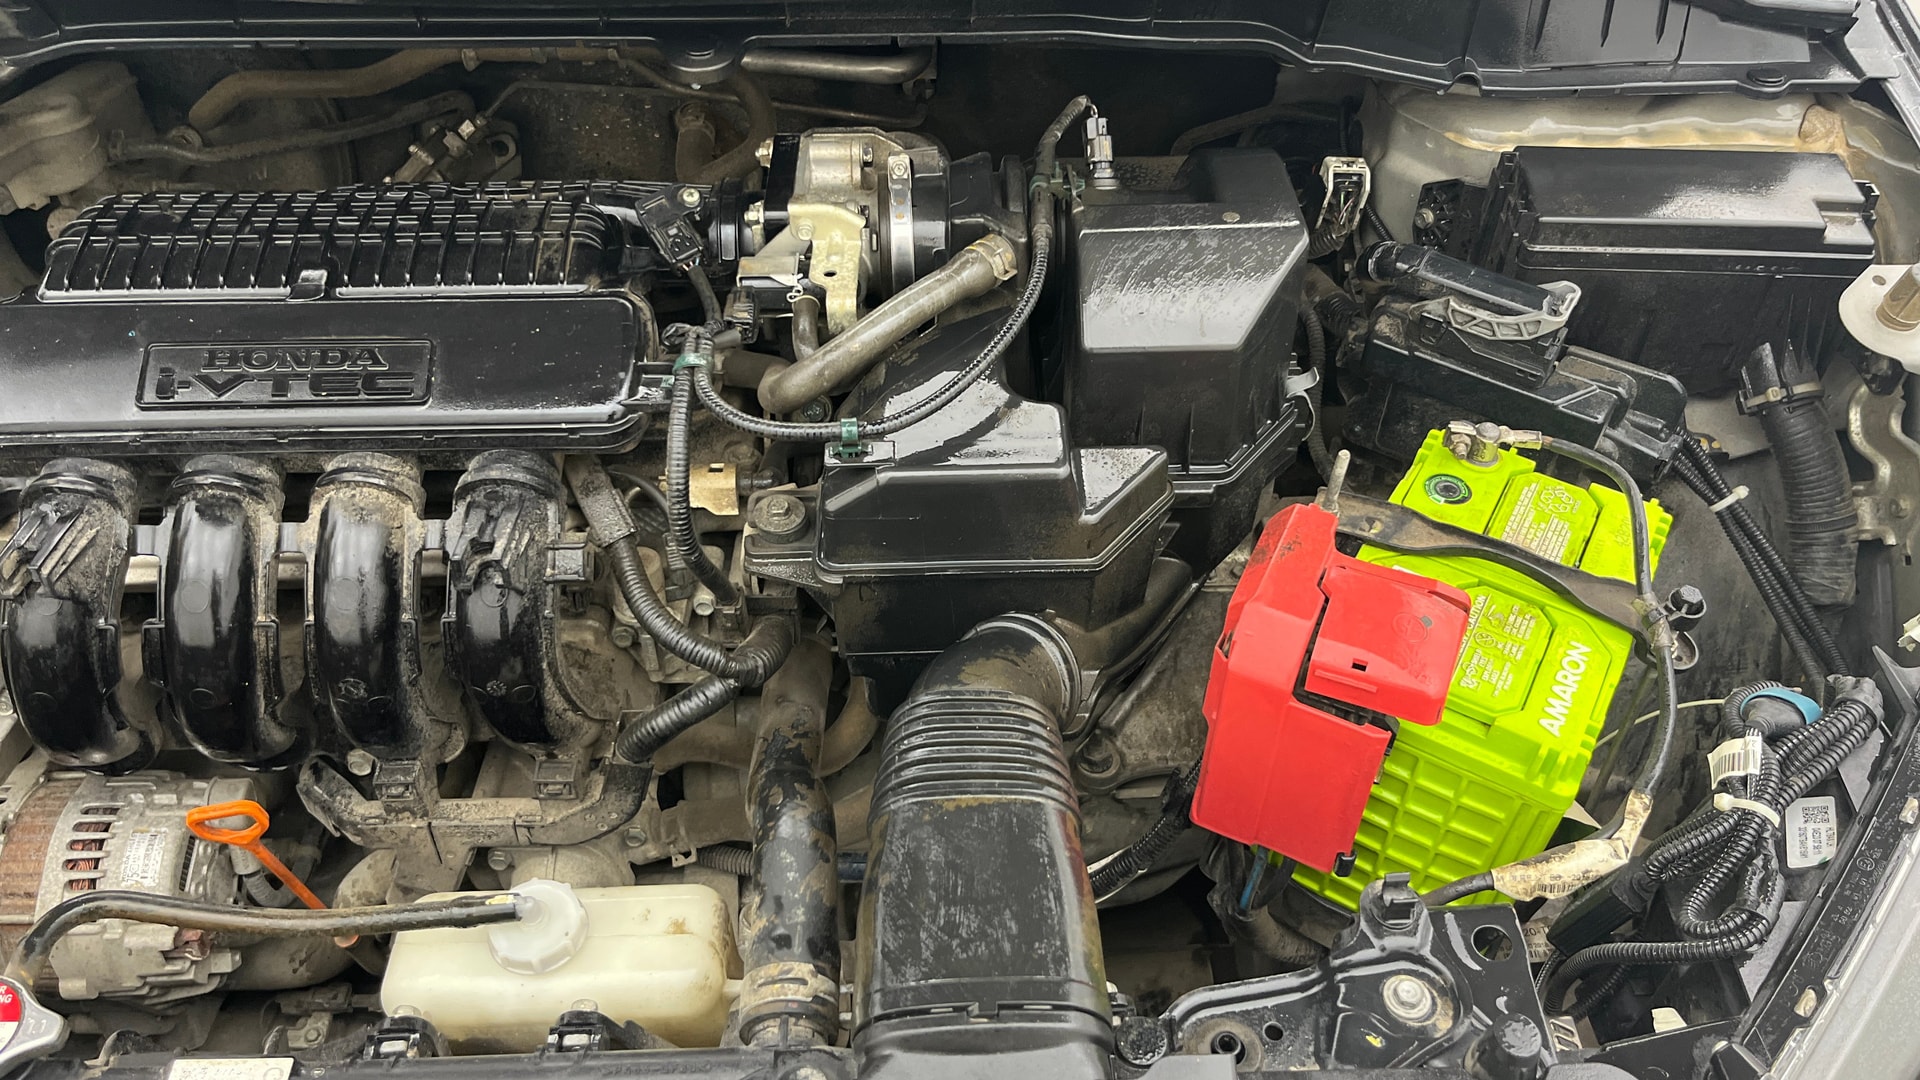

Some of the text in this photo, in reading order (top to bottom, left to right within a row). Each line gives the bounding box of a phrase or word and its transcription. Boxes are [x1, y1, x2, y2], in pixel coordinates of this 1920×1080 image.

[201, 348, 389, 371] HONDA
[155, 366, 415, 399] i-VTEC
[1467, 594, 1486, 629] CAUTION
[1539, 640, 1591, 737] AMARON
